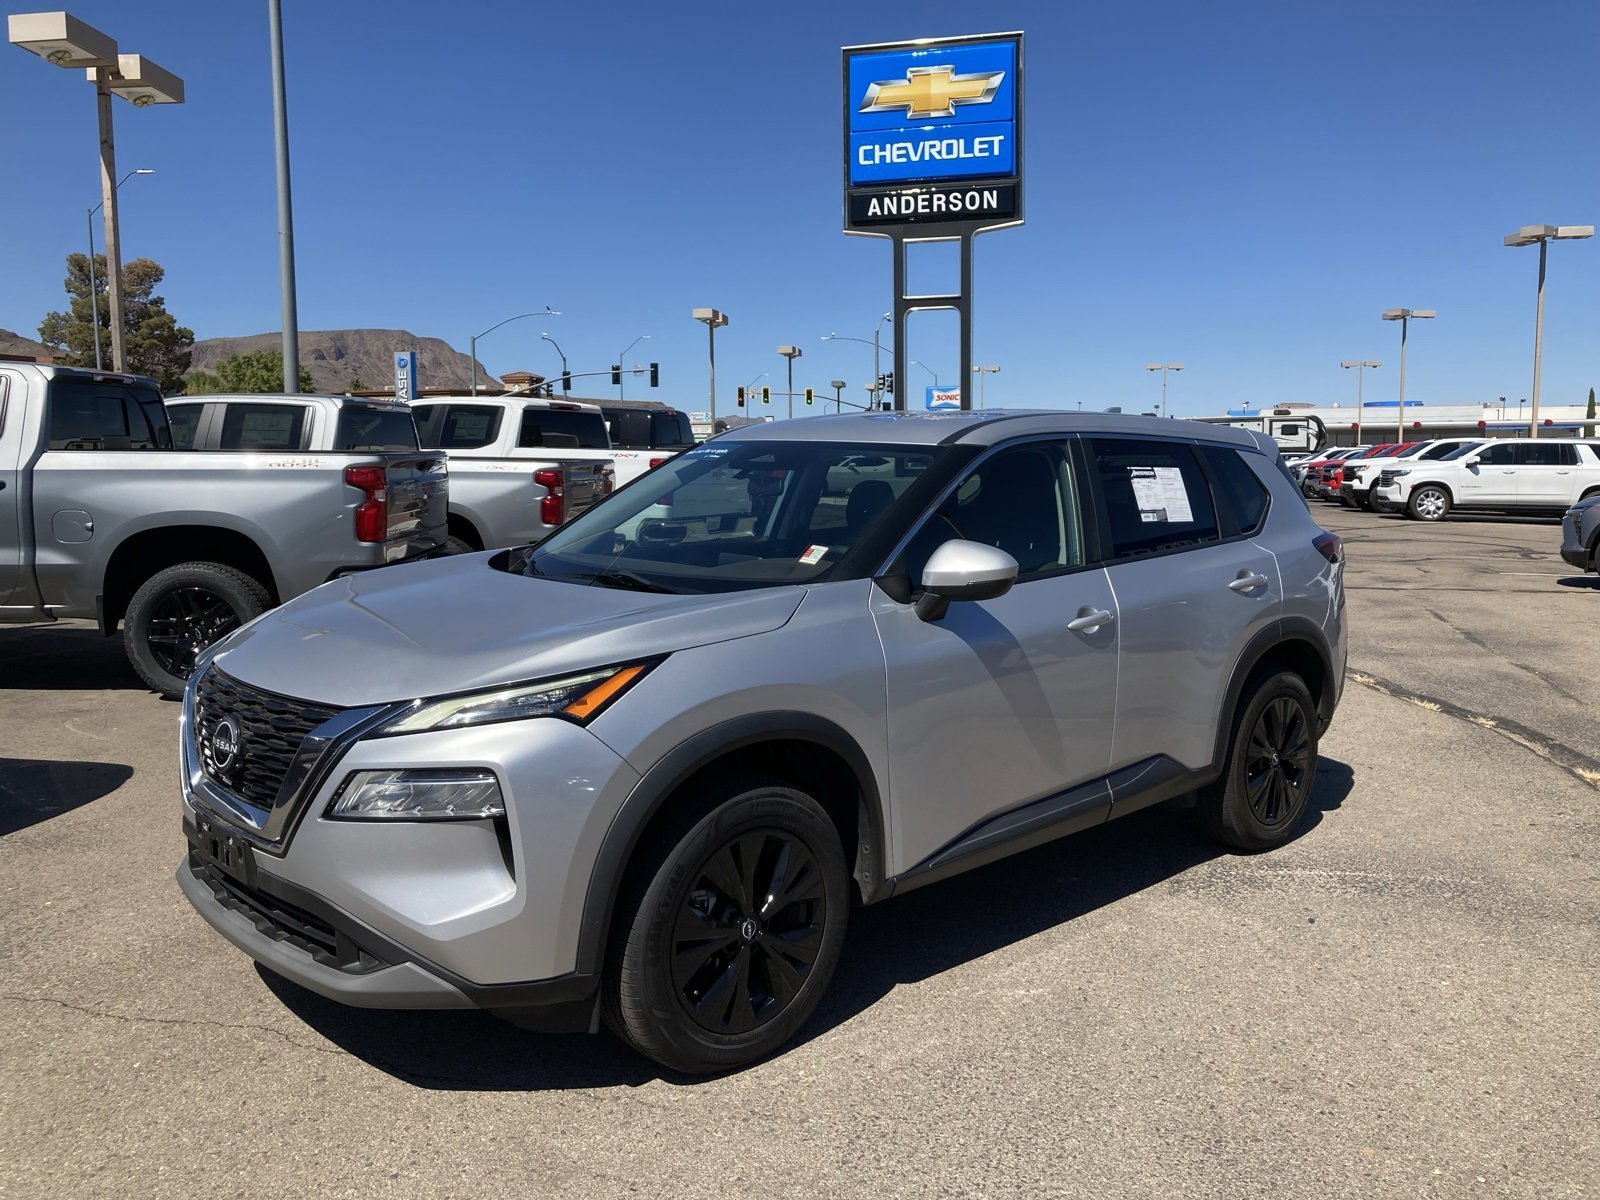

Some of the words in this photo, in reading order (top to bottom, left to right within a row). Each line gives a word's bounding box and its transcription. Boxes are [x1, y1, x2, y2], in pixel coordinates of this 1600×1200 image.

[858, 135, 1005, 166] CHEVROLET
[867, 189, 998, 216] ANDERSON
[397, 370, 408, 403] HASE
[935, 394, 960, 402] SONIC
